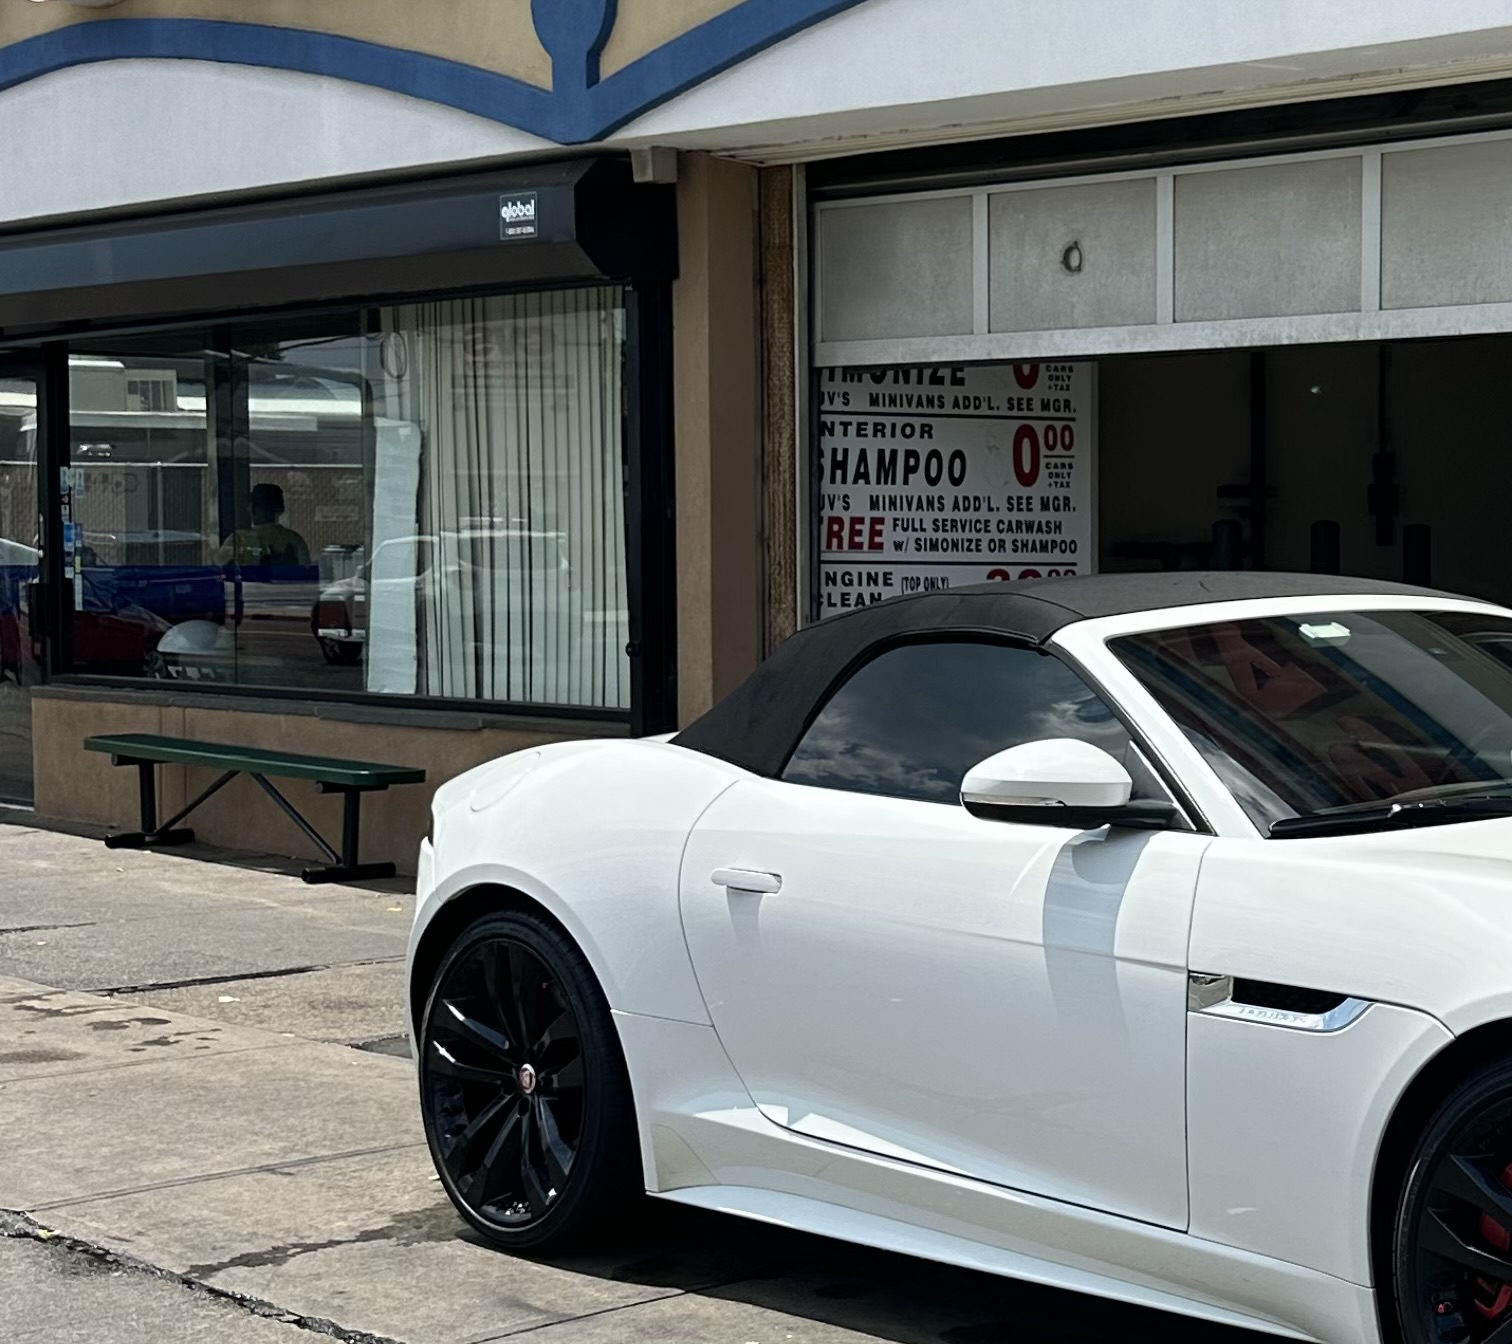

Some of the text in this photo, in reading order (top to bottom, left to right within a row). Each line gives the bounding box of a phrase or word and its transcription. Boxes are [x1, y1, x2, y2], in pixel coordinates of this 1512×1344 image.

[820, 391, 1077, 414] UV'S MINIVANS ADD'L. SEE MGR.
[820, 421, 934, 439] NTERIOR
[820, 447, 967, 487] HAMPOO
[820, 493, 1077, 513] UV'S MINIVANS ADD'L. SEE MGR.
[820, 516, 885, 551] REE
[892, 517, 1062, 535] FULL SERVICE CARWASH
[914, 537, 982, 553] SIMONIZE
[988, 538, 1007, 553] OR
[1011, 539, 1078, 554] SHAMPOO
[823, 571, 894, 587] NGINE
[820, 591, 882, 608] LEAN
